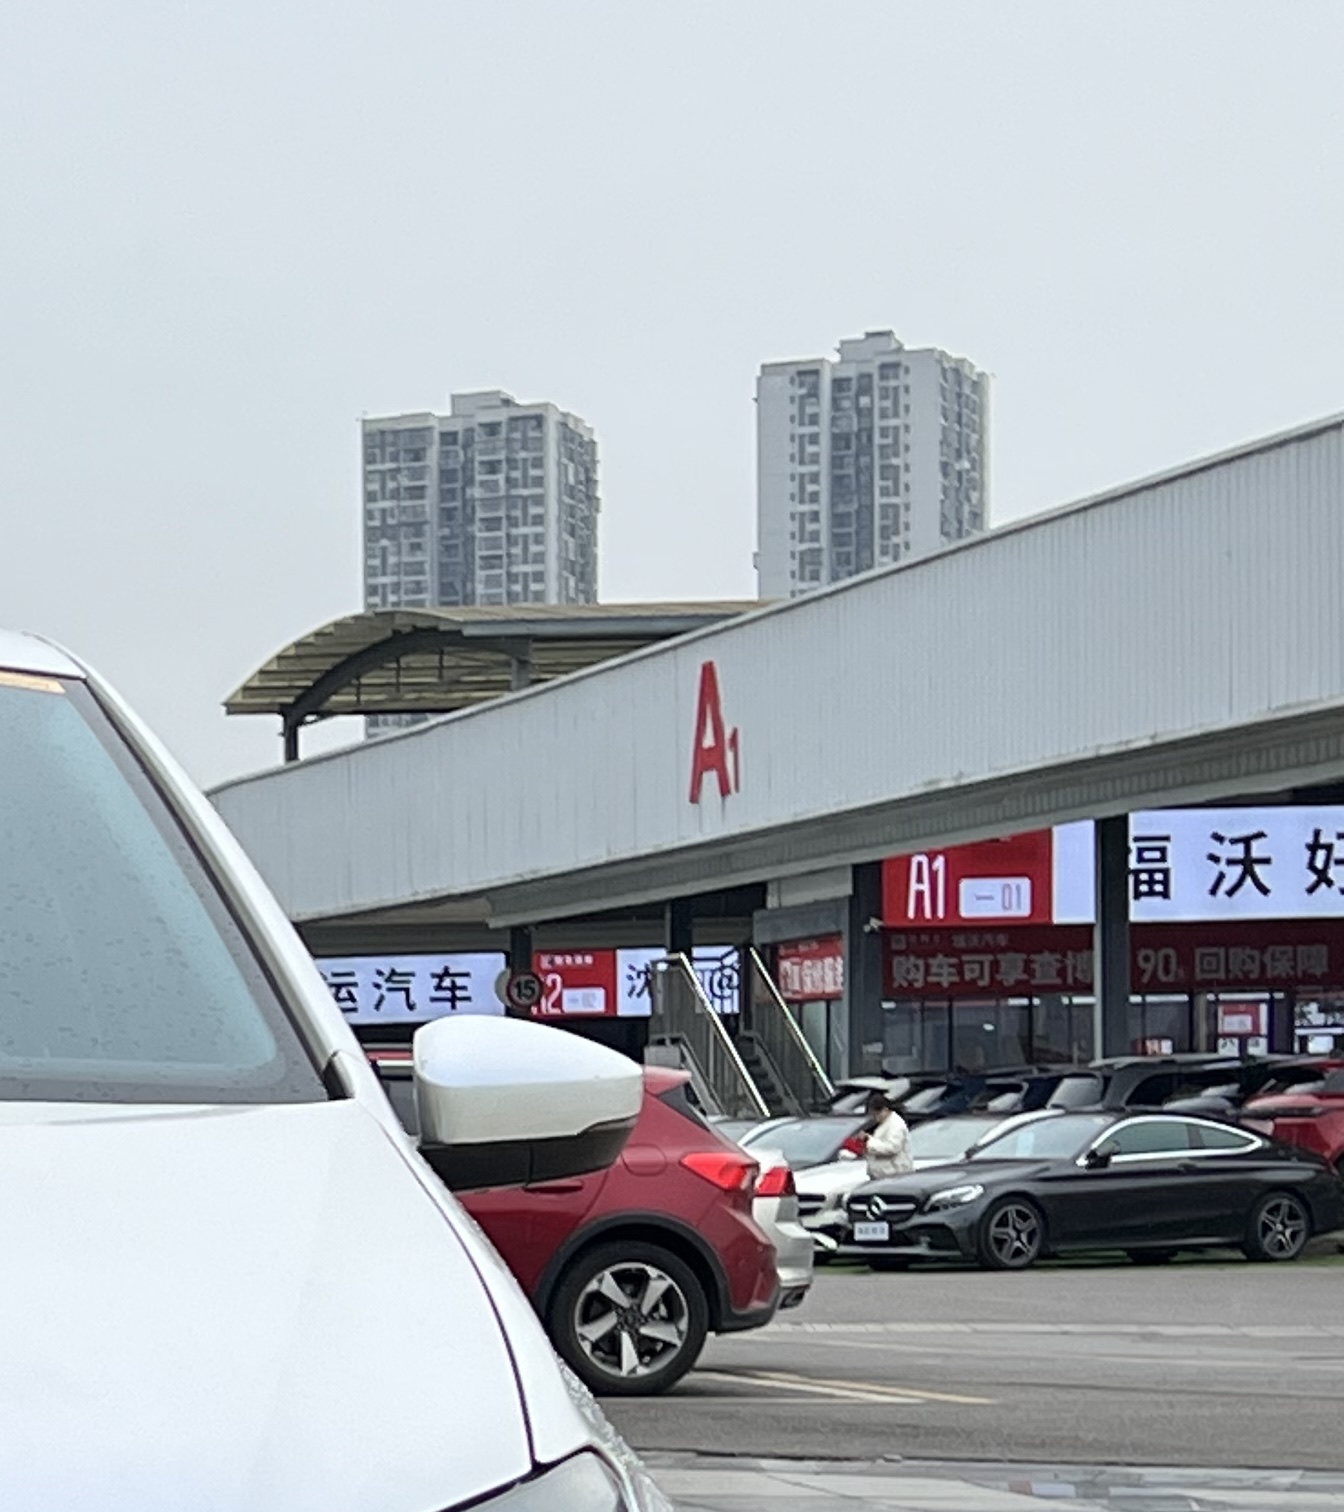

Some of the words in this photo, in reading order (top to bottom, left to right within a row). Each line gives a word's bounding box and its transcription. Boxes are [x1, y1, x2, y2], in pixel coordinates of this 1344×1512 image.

[689, 660, 740, 804] A1
[907, 854, 946, 919] A1
[514, 979, 536, 999] 15
